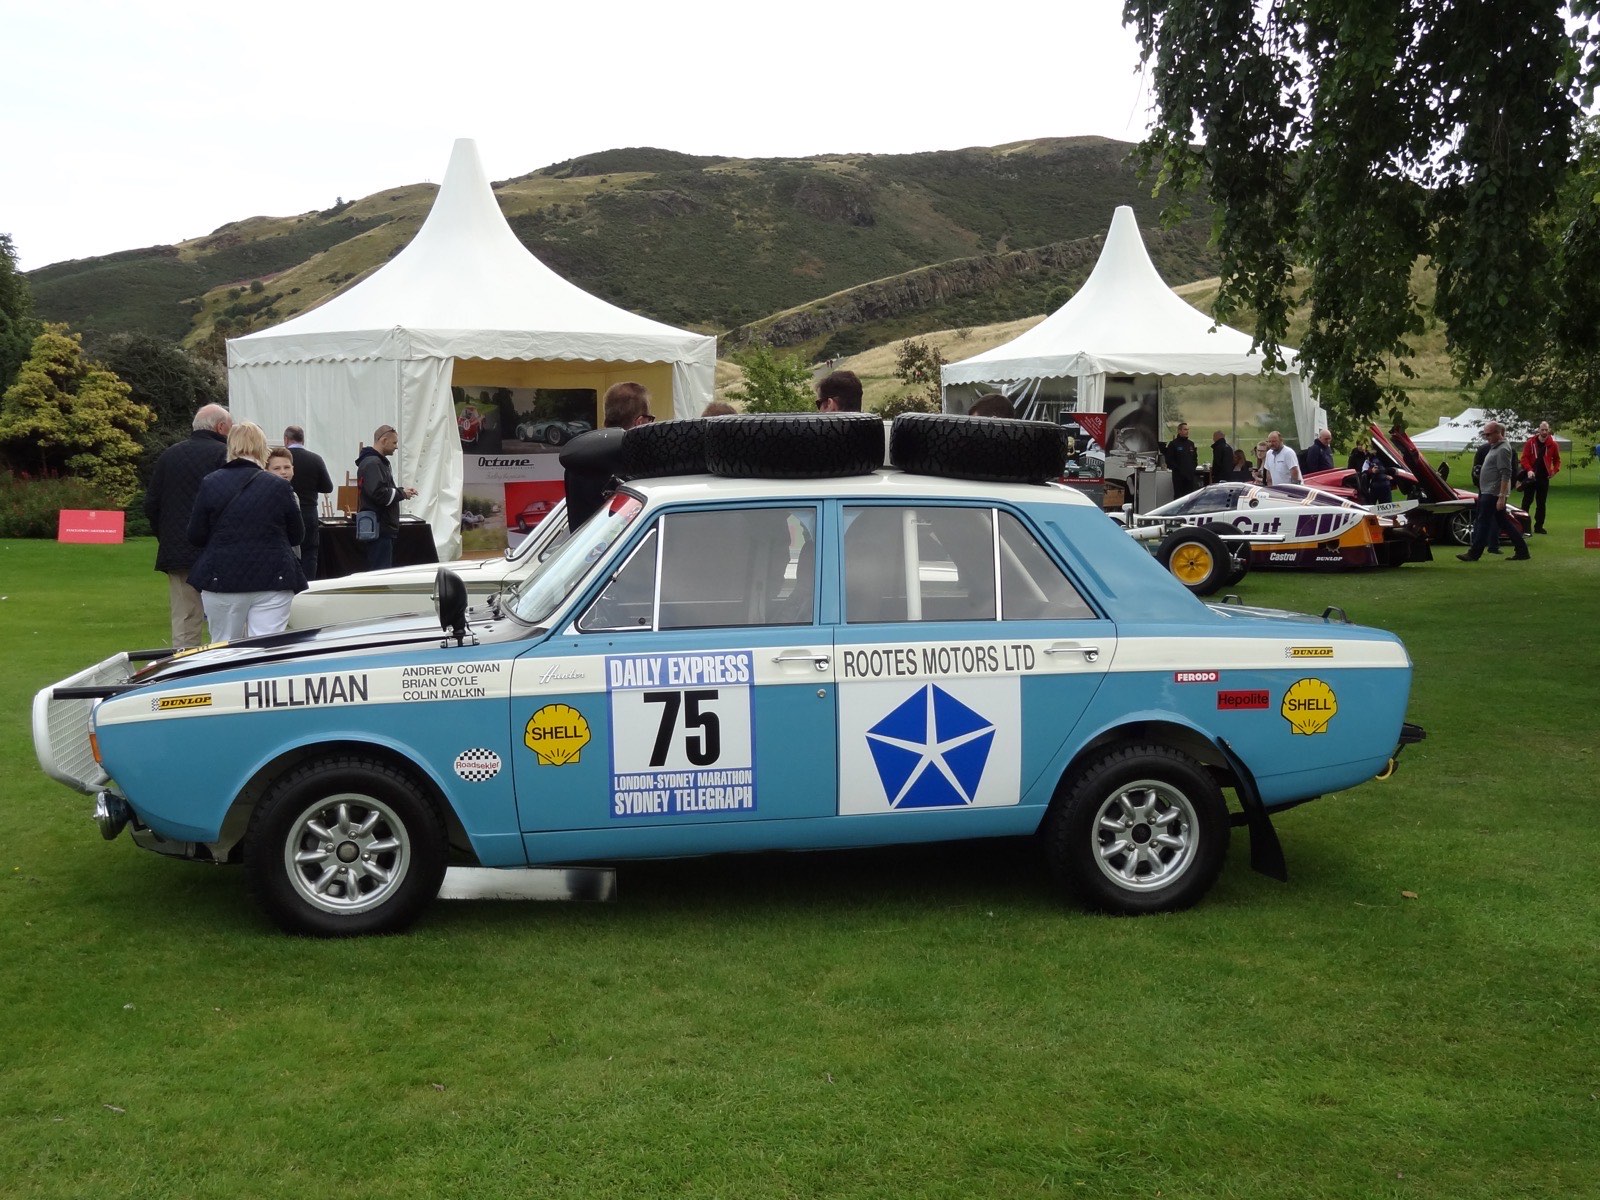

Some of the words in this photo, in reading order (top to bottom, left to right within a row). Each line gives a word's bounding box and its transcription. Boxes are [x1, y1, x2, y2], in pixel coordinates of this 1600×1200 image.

[478, 456, 534, 467] Octane
[1232, 516, 1281, 535] Cut
[1269, 552, 1297, 561] Castrol
[843, 648, 918, 677] ROOTES
[922, 646, 999, 674] MOTORS
[1003, 644, 1035, 671] LTD
[402, 666, 453, 677] ANDREW
[457, 663, 500, 674] COWAN
[539, 664, 585, 684] Hunter
[610, 657, 662, 687] DAILY
[668, 654, 750, 685] EXPRESS
[1177, 672, 1216, 682] FERODO
[402, 678, 437, 689] BRIAN
[440, 676, 478, 687] COYLE
[244, 674, 368, 709] HILLMAN
[403, 690, 438, 701] COLIN
[441, 688, 485, 699] MALKIN
[161, 696, 212, 707] DUNLOP
[1218, 693, 1269, 707] Hepolite
[1288, 698, 1331, 711] SHELL
[532, 725, 583, 741] SHELL
[643, 689, 721, 767] 75
[614, 772, 695, 791] LONDON-SYDNEY
[697, 770, 752, 787] MARATHON
[614, 790, 670, 815] SYDNEY
[674, 786, 753, 811] TELEGRAPH
